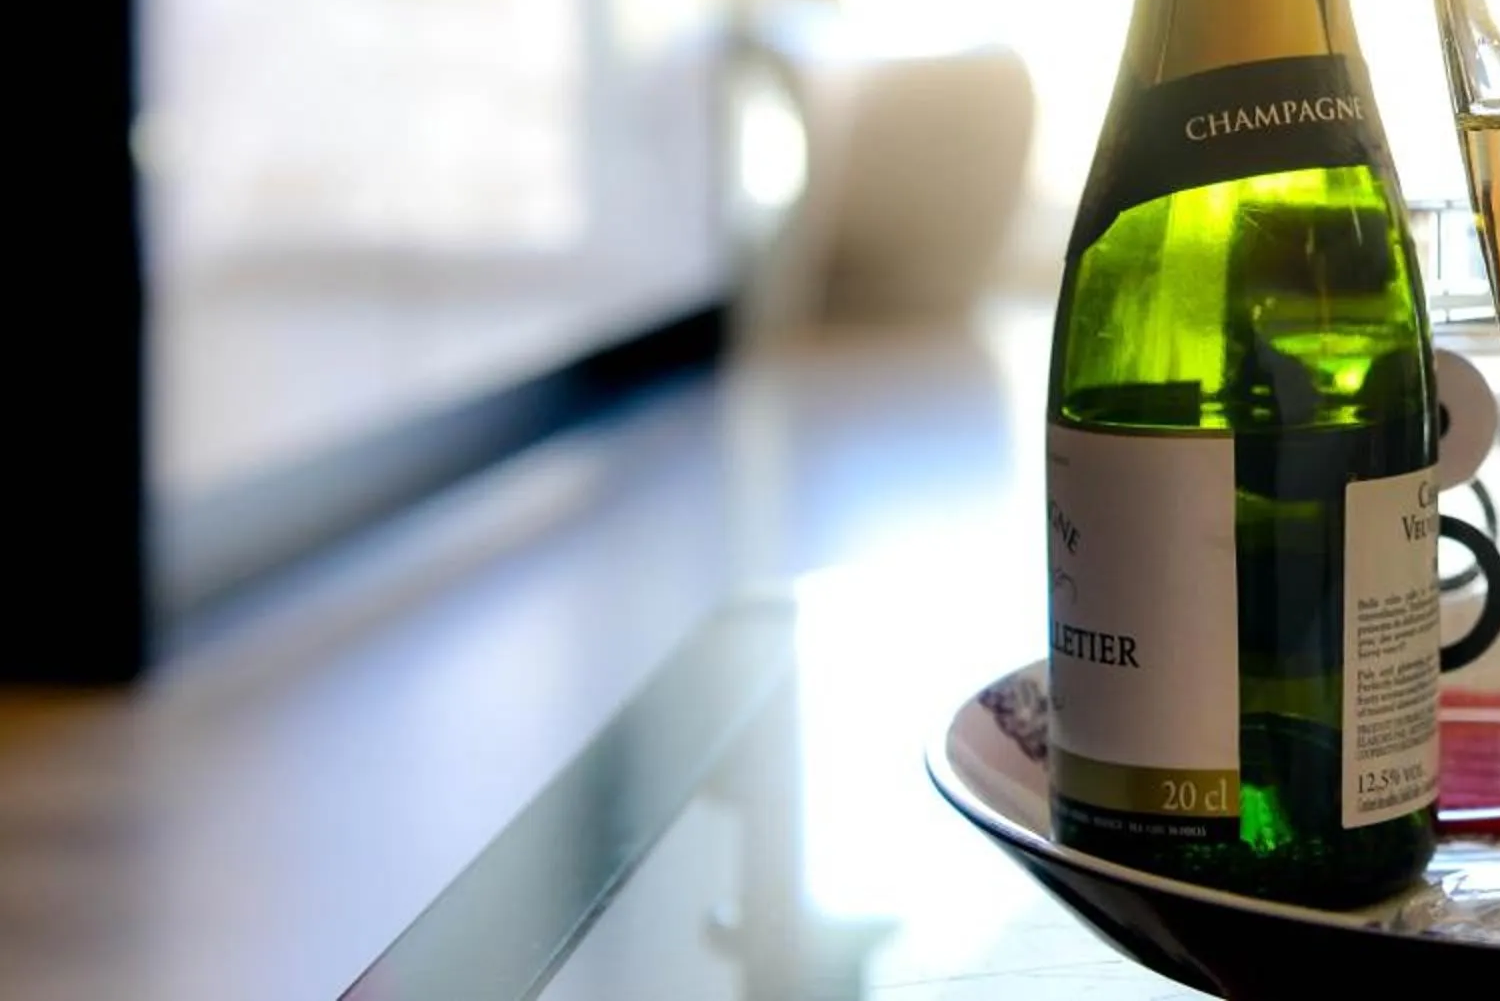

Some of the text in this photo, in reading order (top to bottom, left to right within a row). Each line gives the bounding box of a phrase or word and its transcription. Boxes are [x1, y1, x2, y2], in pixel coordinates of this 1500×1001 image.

[1184, 96, 1364, 141] CHAMPAGNE
[1051, 620, 1140, 669] LETIER
[1161, 777, 1228, 812] 20 cl
